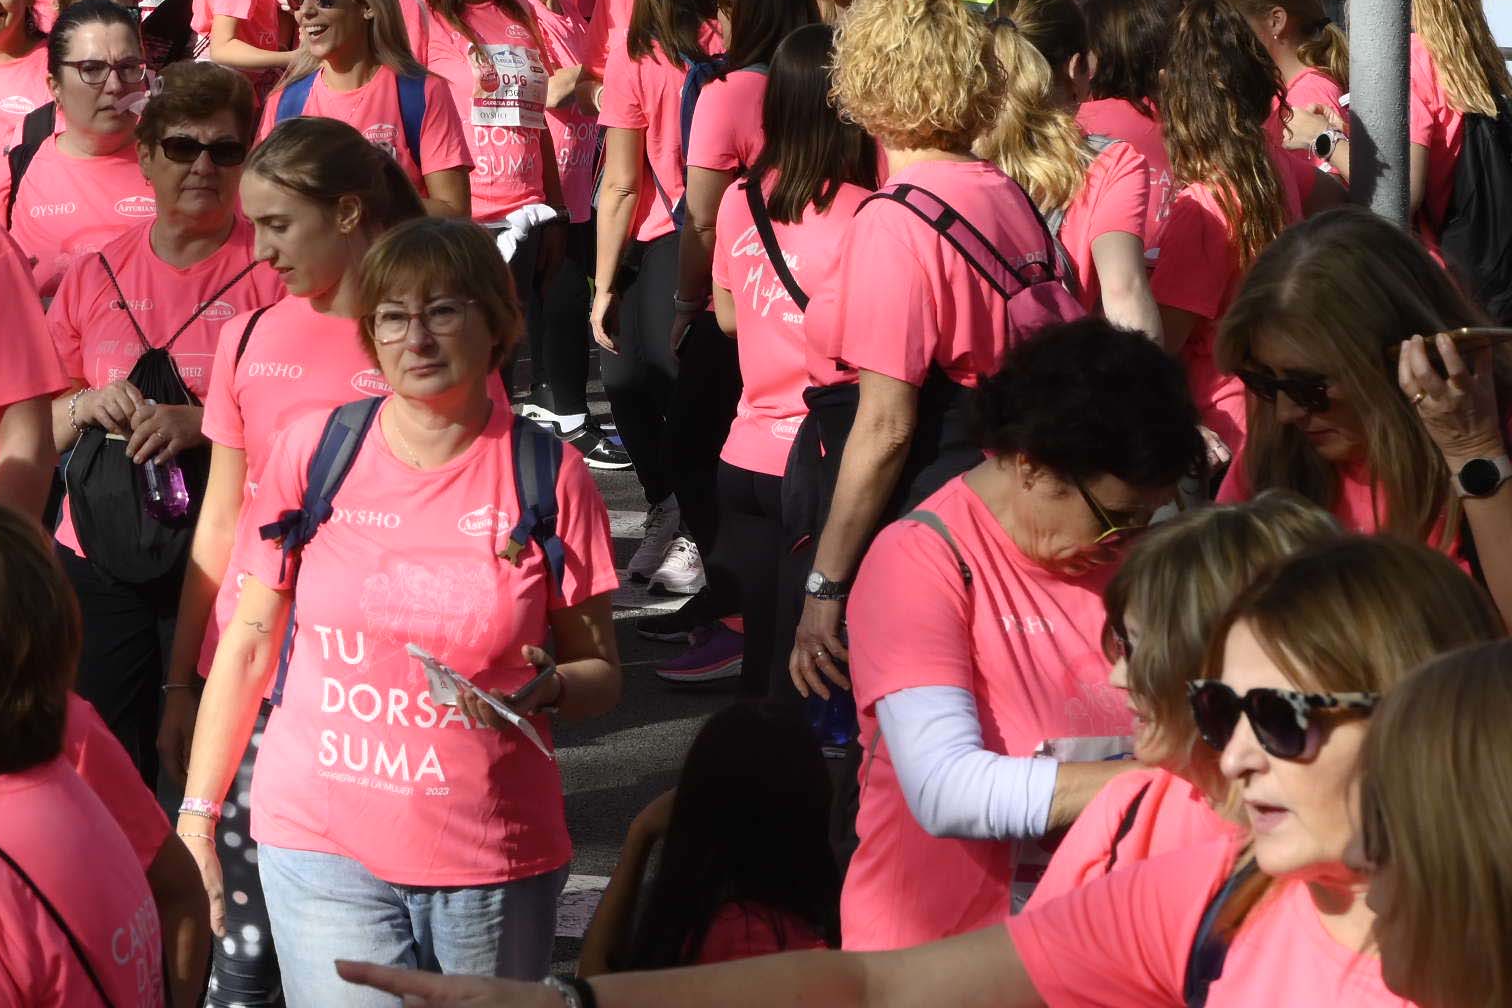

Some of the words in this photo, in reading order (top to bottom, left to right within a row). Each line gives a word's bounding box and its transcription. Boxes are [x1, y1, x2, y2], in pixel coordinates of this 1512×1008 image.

[502, 73, 527, 87] 016
[476, 155, 535, 176] SUMA
[31, 202, 76, 217] OYSHO
[248, 362, 304, 379] OYSHO
[313, 625, 365, 665] TU
[321, 677, 490, 730] DORSA
[319, 729, 446, 783] SUMA
[320, 770, 355, 784] CARRERA
